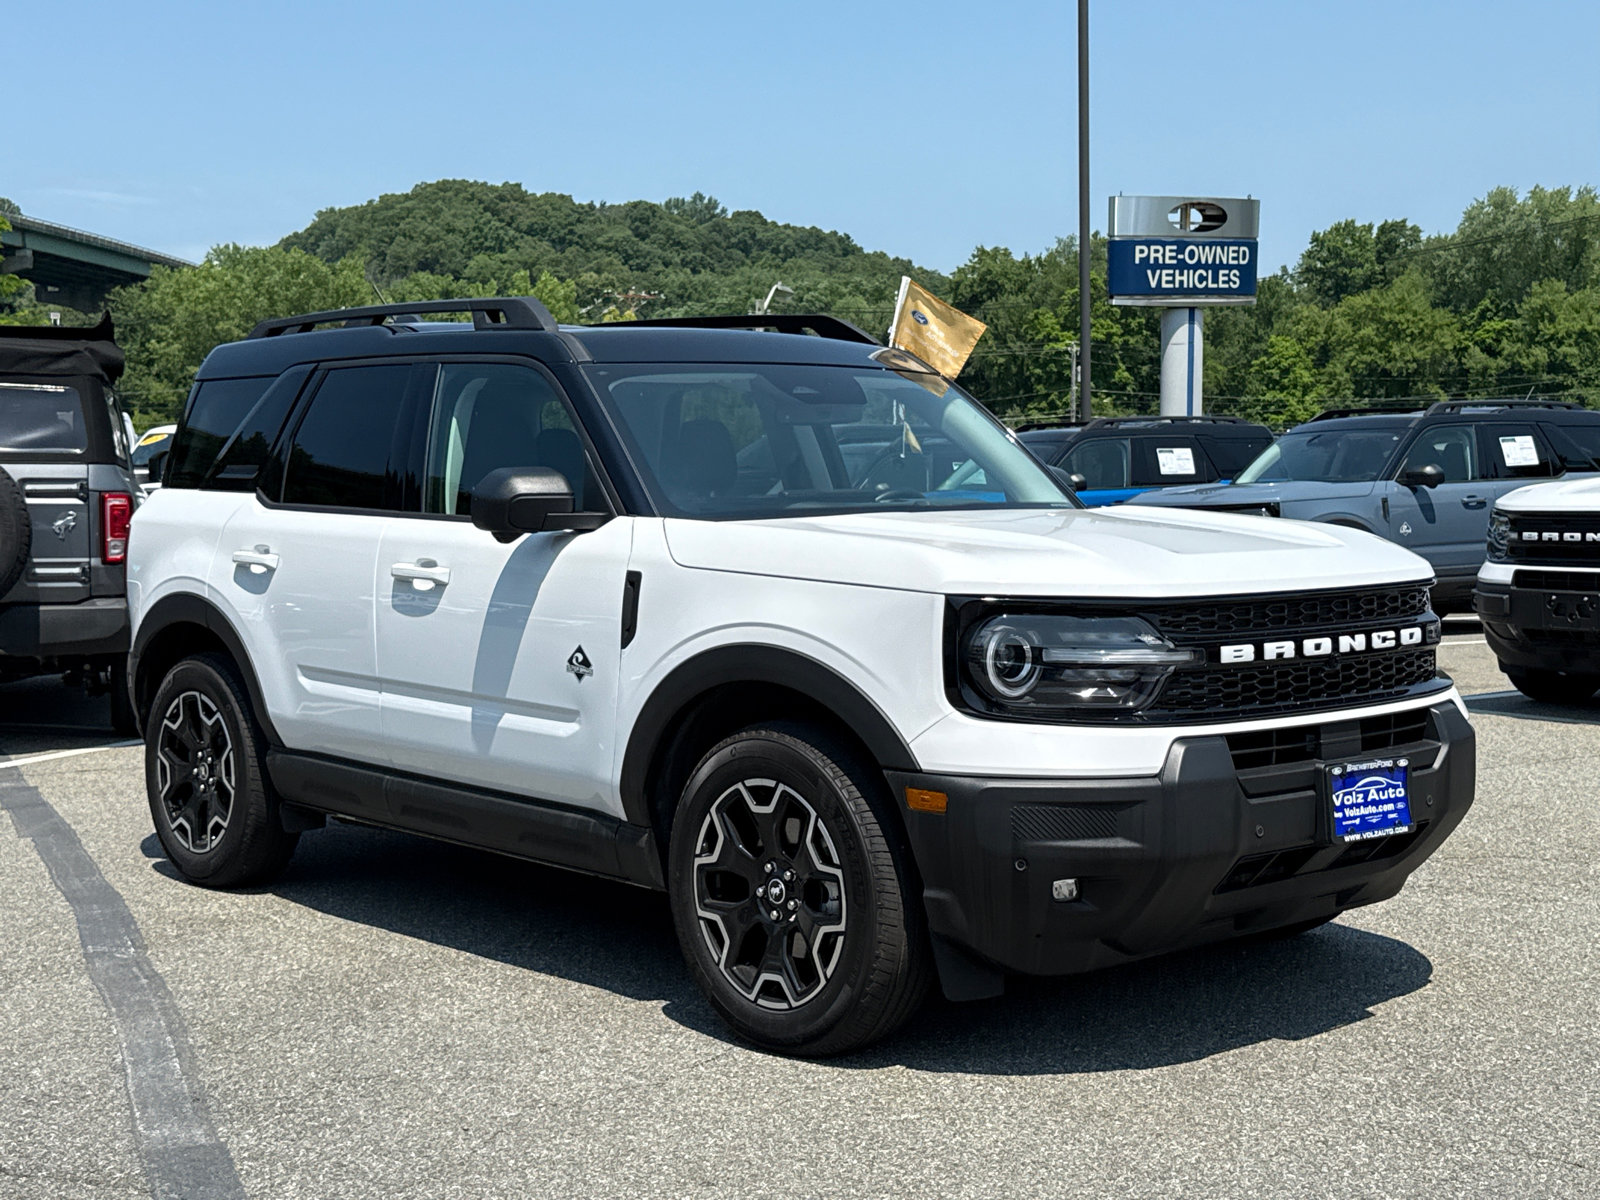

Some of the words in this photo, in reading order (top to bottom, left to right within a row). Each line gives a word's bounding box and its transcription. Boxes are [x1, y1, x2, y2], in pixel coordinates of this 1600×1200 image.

[1135, 245, 1250, 265] PRE-OWNED
[1147, 269, 1241, 289] VEHICLES
[1522, 531, 1600, 542] BRON
[1220, 627, 1422, 664] BRONCO
[1332, 791, 1365, 807] Volz
[1367, 787, 1405, 802] Auto
[1344, 803, 1395, 818] VolzAuto.com
[1344, 825, 1409, 842] WWW.VOLZAUTO.COM
